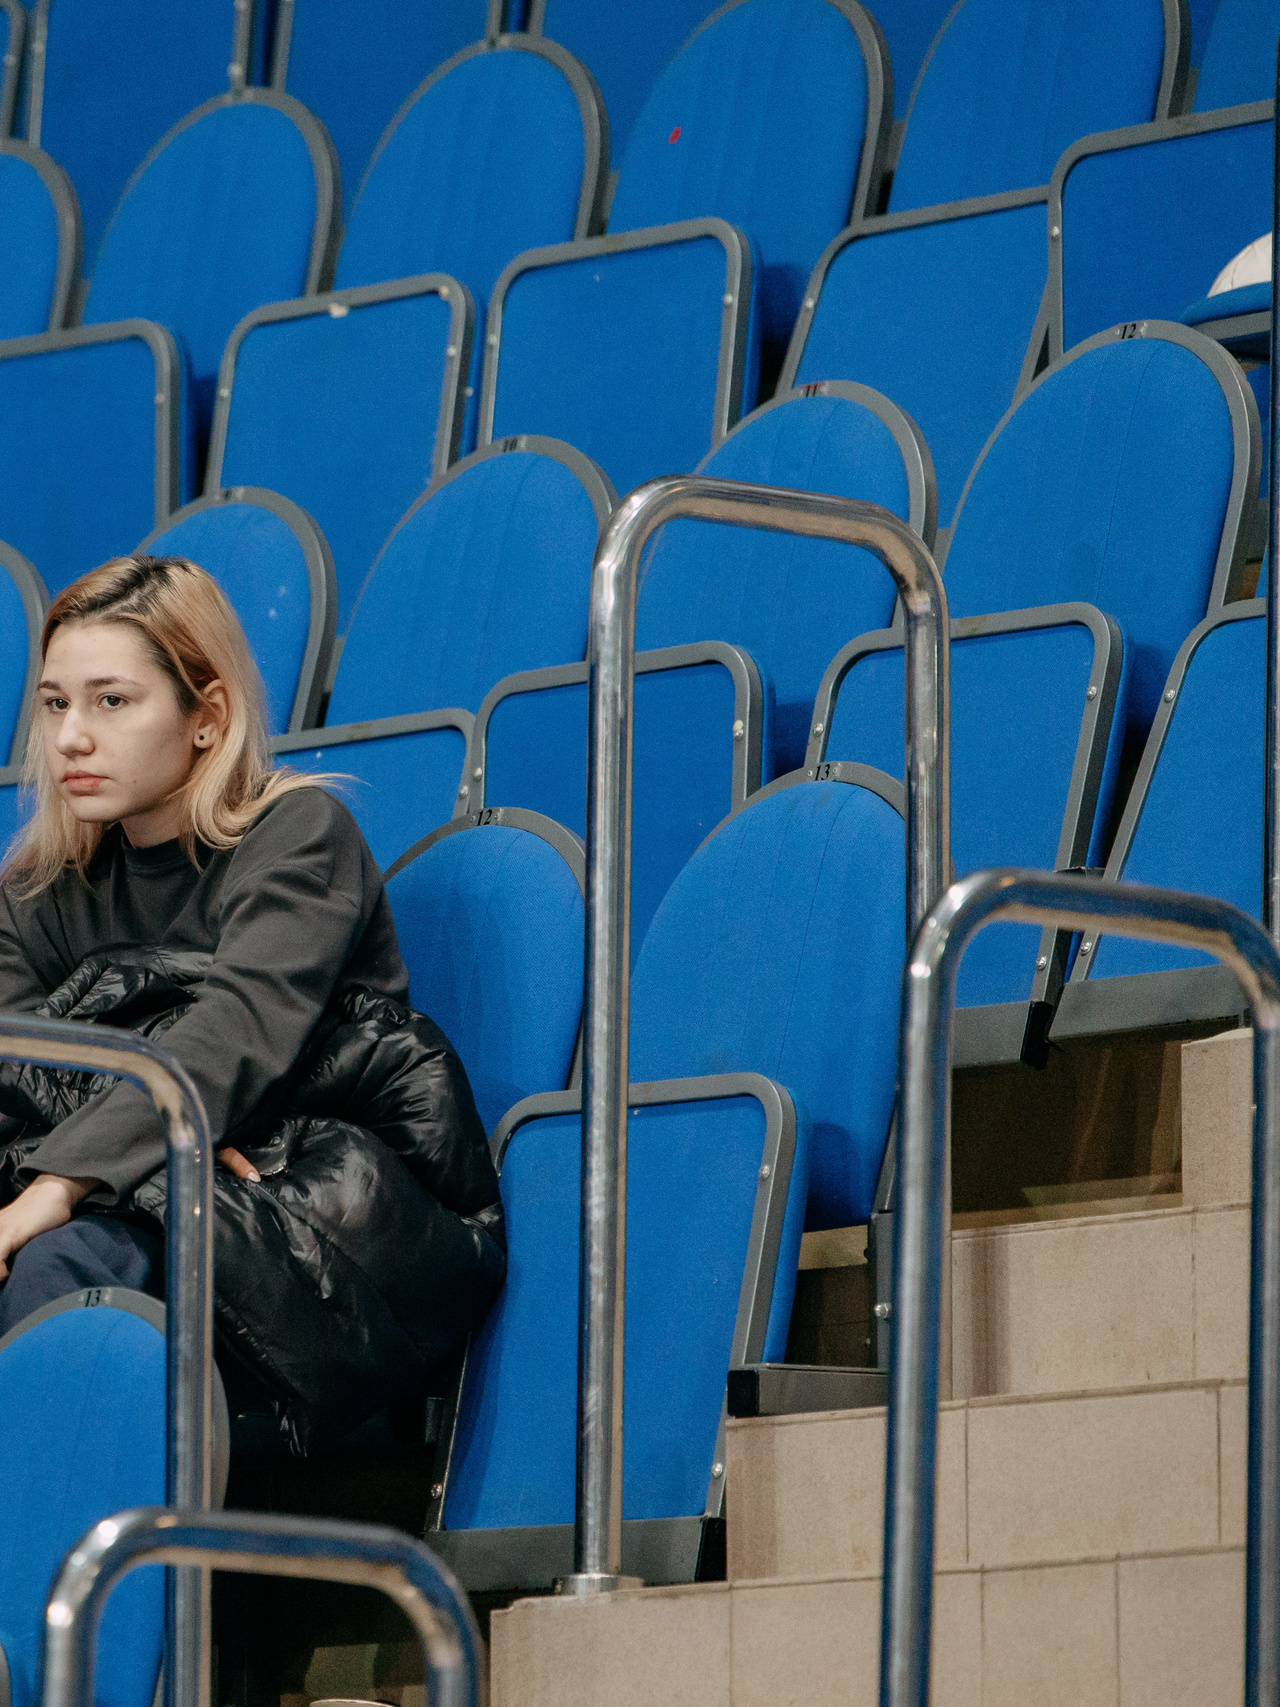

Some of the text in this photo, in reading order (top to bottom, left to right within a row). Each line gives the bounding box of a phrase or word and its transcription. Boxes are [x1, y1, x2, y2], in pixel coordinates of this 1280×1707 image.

[1121, 323, 1137, 339] 12
[806, 383, 818, 397] 11
[814, 764, 830, 781] 13
[477, 809, 492, 825] 12
[86, 1291, 101, 1307] 13
